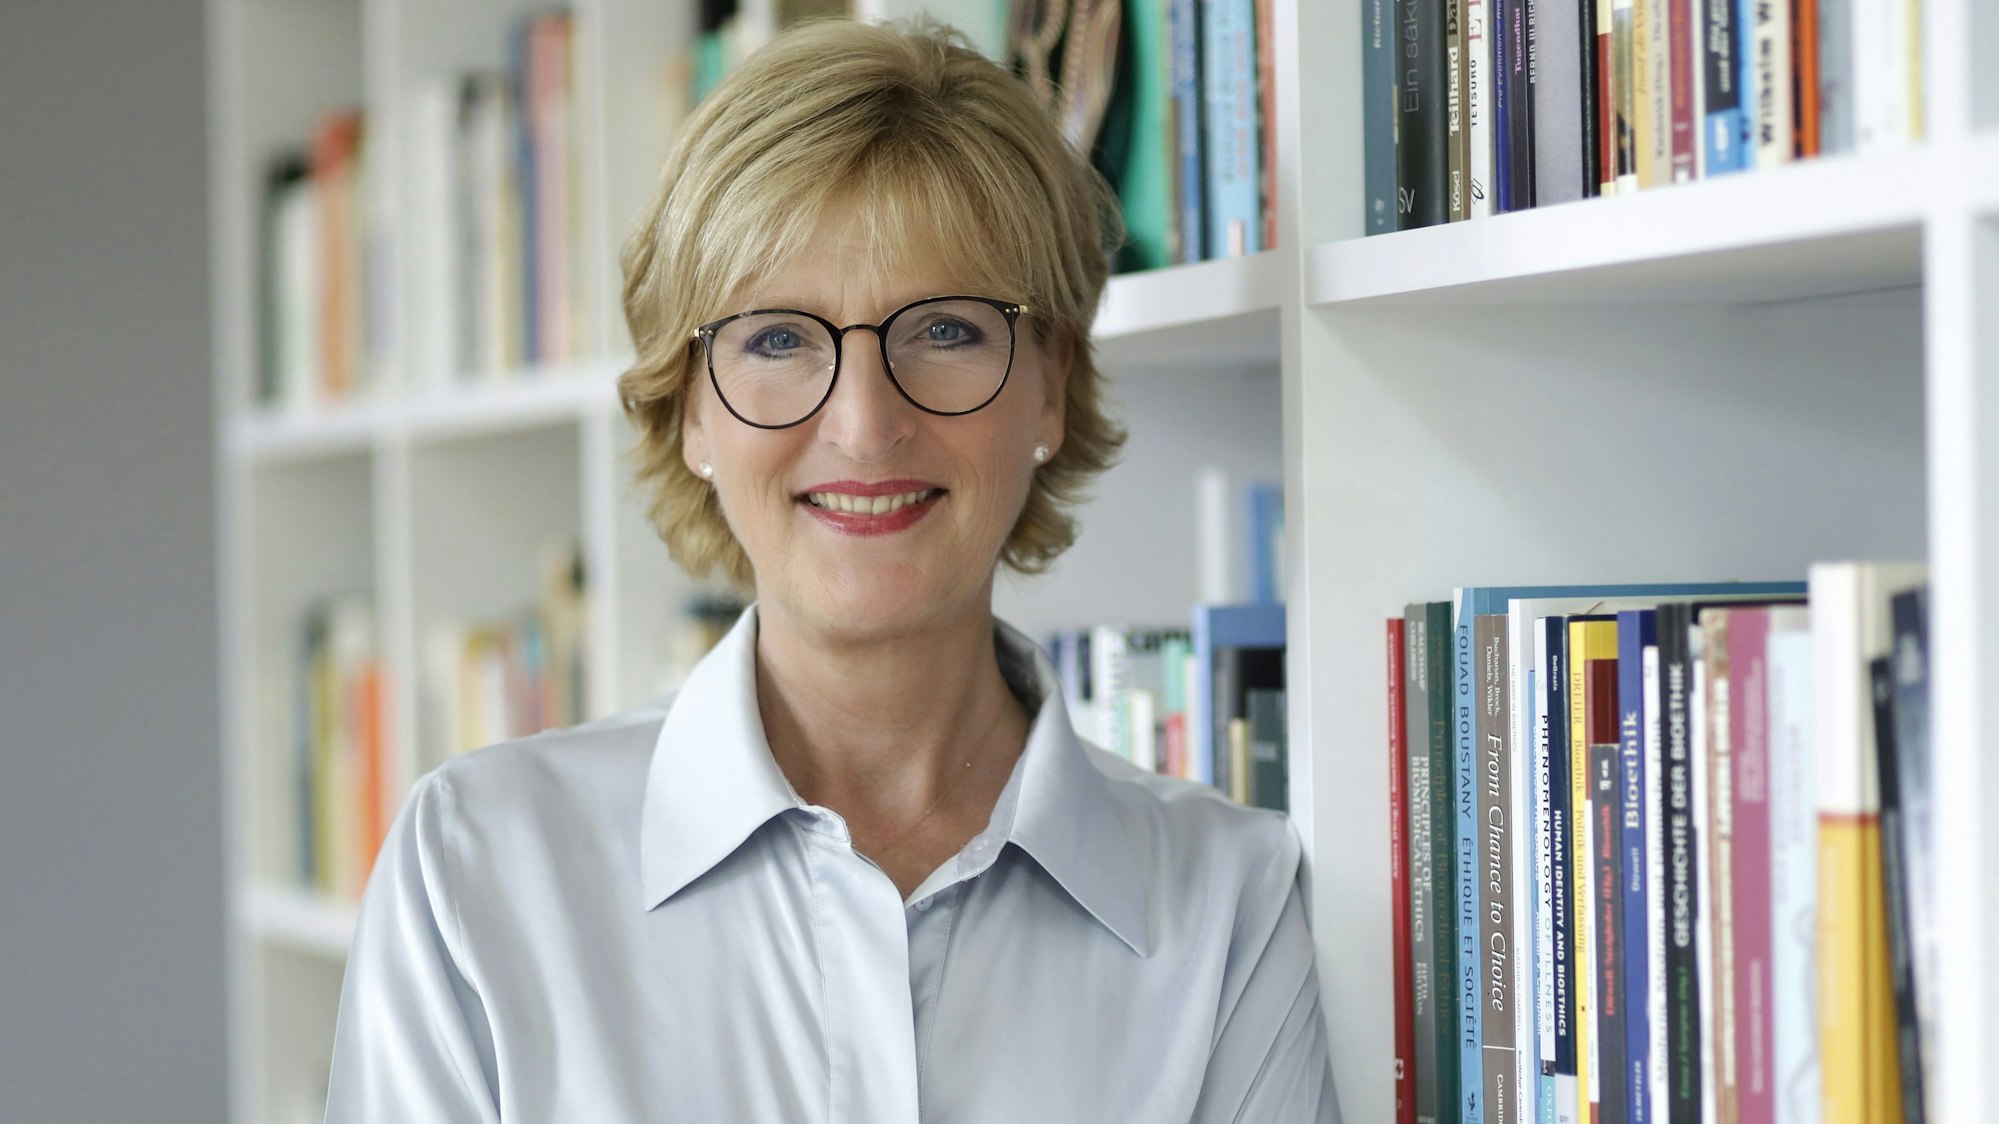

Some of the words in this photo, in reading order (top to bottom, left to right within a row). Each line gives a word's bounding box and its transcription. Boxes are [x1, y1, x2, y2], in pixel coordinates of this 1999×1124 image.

[1514, 6, 1522, 75] Tugendhat
[1404, 68, 1419, 112] Ein
[1448, 46, 1460, 136] Teilhard
[1470, 59, 1478, 127] TETSURO
[1399, 186, 1415, 214] SV
[1452, 170, 1462, 211] Kösel
[1459, 626, 1469, 696] FOUAD
[1486, 646, 1495, 684] Daniels,
[1493, 637, 1502, 684] Buchanan,
[1487, 685, 1496, 715] Wikler
[1493, 687, 1502, 716] Brock,
[1573, 672, 1583, 725] DREIER
[1668, 663, 1686, 760] BIOETHIK
[1432, 720, 1446, 822] Principles
[1460, 707, 1471, 818] BOUSTANY
[1486, 733, 1502, 797] From
[1574, 740, 1585, 793] Bioethik
[1622, 710, 1640, 829] Bioethik
[1671, 766, 1687, 809] DER
[1412, 757, 1423, 874] BIOMEDICAL
[1421, 757, 1431, 862] PRINCIPLES
[1436, 825, 1448, 843] of
[1542, 715, 1551, 908] PHENOMENOLOGY
[1554, 811, 1563, 861] HUMAN
[1575, 810, 1585, 850] Politik
[1422, 867, 1432, 892] OF
[1489, 806, 1505, 893] Chance
[1576, 855, 1586, 879] und
[1671, 814, 1689, 946] GESCHICHTE
[1414, 878, 1424, 943] ETHICS
[1436, 853, 1450, 964] Biomedical
[1462, 838, 1474, 925] ÉTHIQUE
[1490, 901, 1504, 924] to
[1555, 866, 1565, 927] IDENTITY
[1463, 936, 1473, 961] ET
[1544, 917, 1552, 943] OF
[1556, 931, 1565, 961] AND
[1576, 882, 1587, 953] Verfassung
[1415, 962, 1423, 1015] EDITION
[1438, 972, 1451, 1034] Ethics
[1491, 932, 1507, 1012] Choice
[1545, 953, 1553, 1034] ILLNESS
[1557, 964, 1567, 1036] BIOETHICS
[1464, 966, 1477, 1049] SOCIÉTÉ
